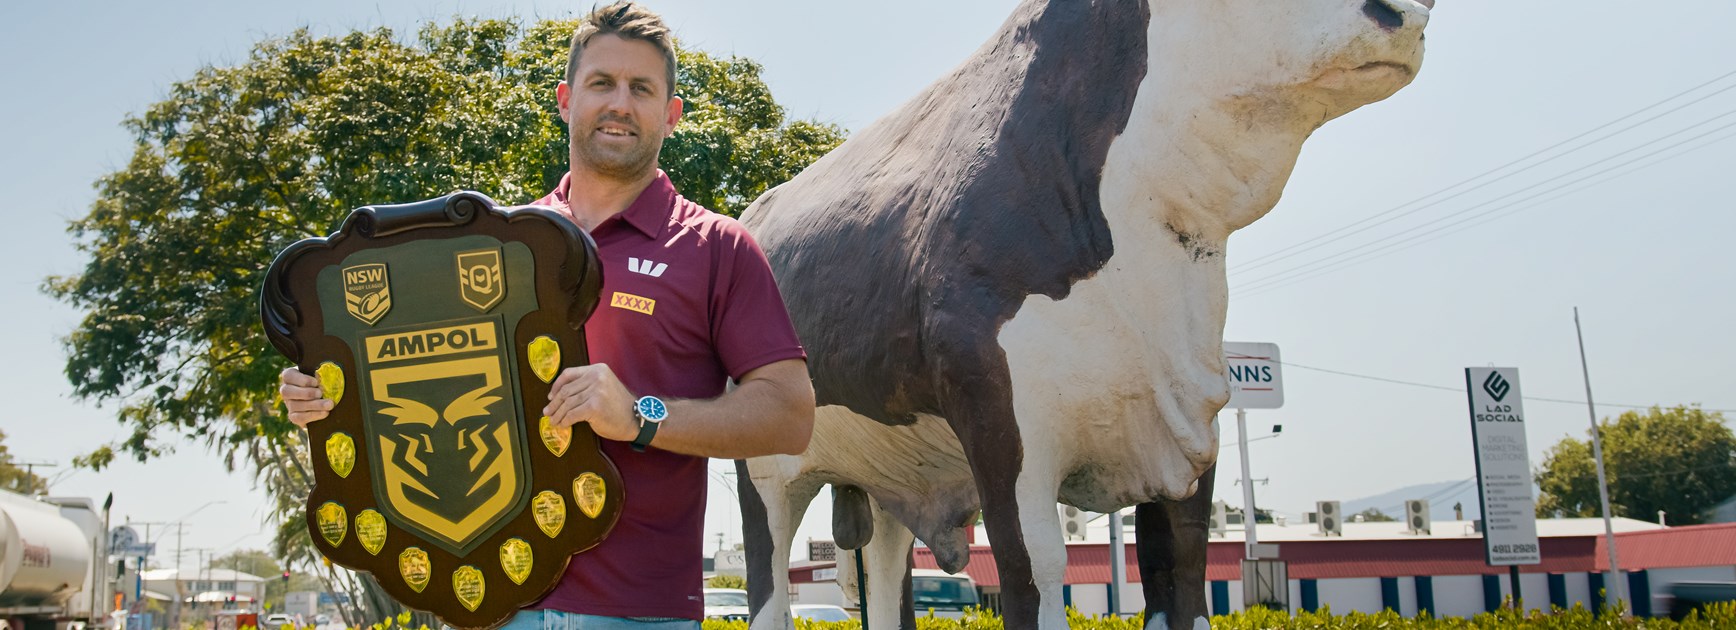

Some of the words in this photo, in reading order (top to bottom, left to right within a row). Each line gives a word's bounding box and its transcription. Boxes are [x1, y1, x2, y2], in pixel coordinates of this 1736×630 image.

[346, 268, 383, 285] NSW
[615, 294, 651, 311] XXXX
[377, 328, 488, 358] AMPOL
[1485, 404, 1512, 413] LAD
[1476, 414, 1523, 422] SOCIAL
